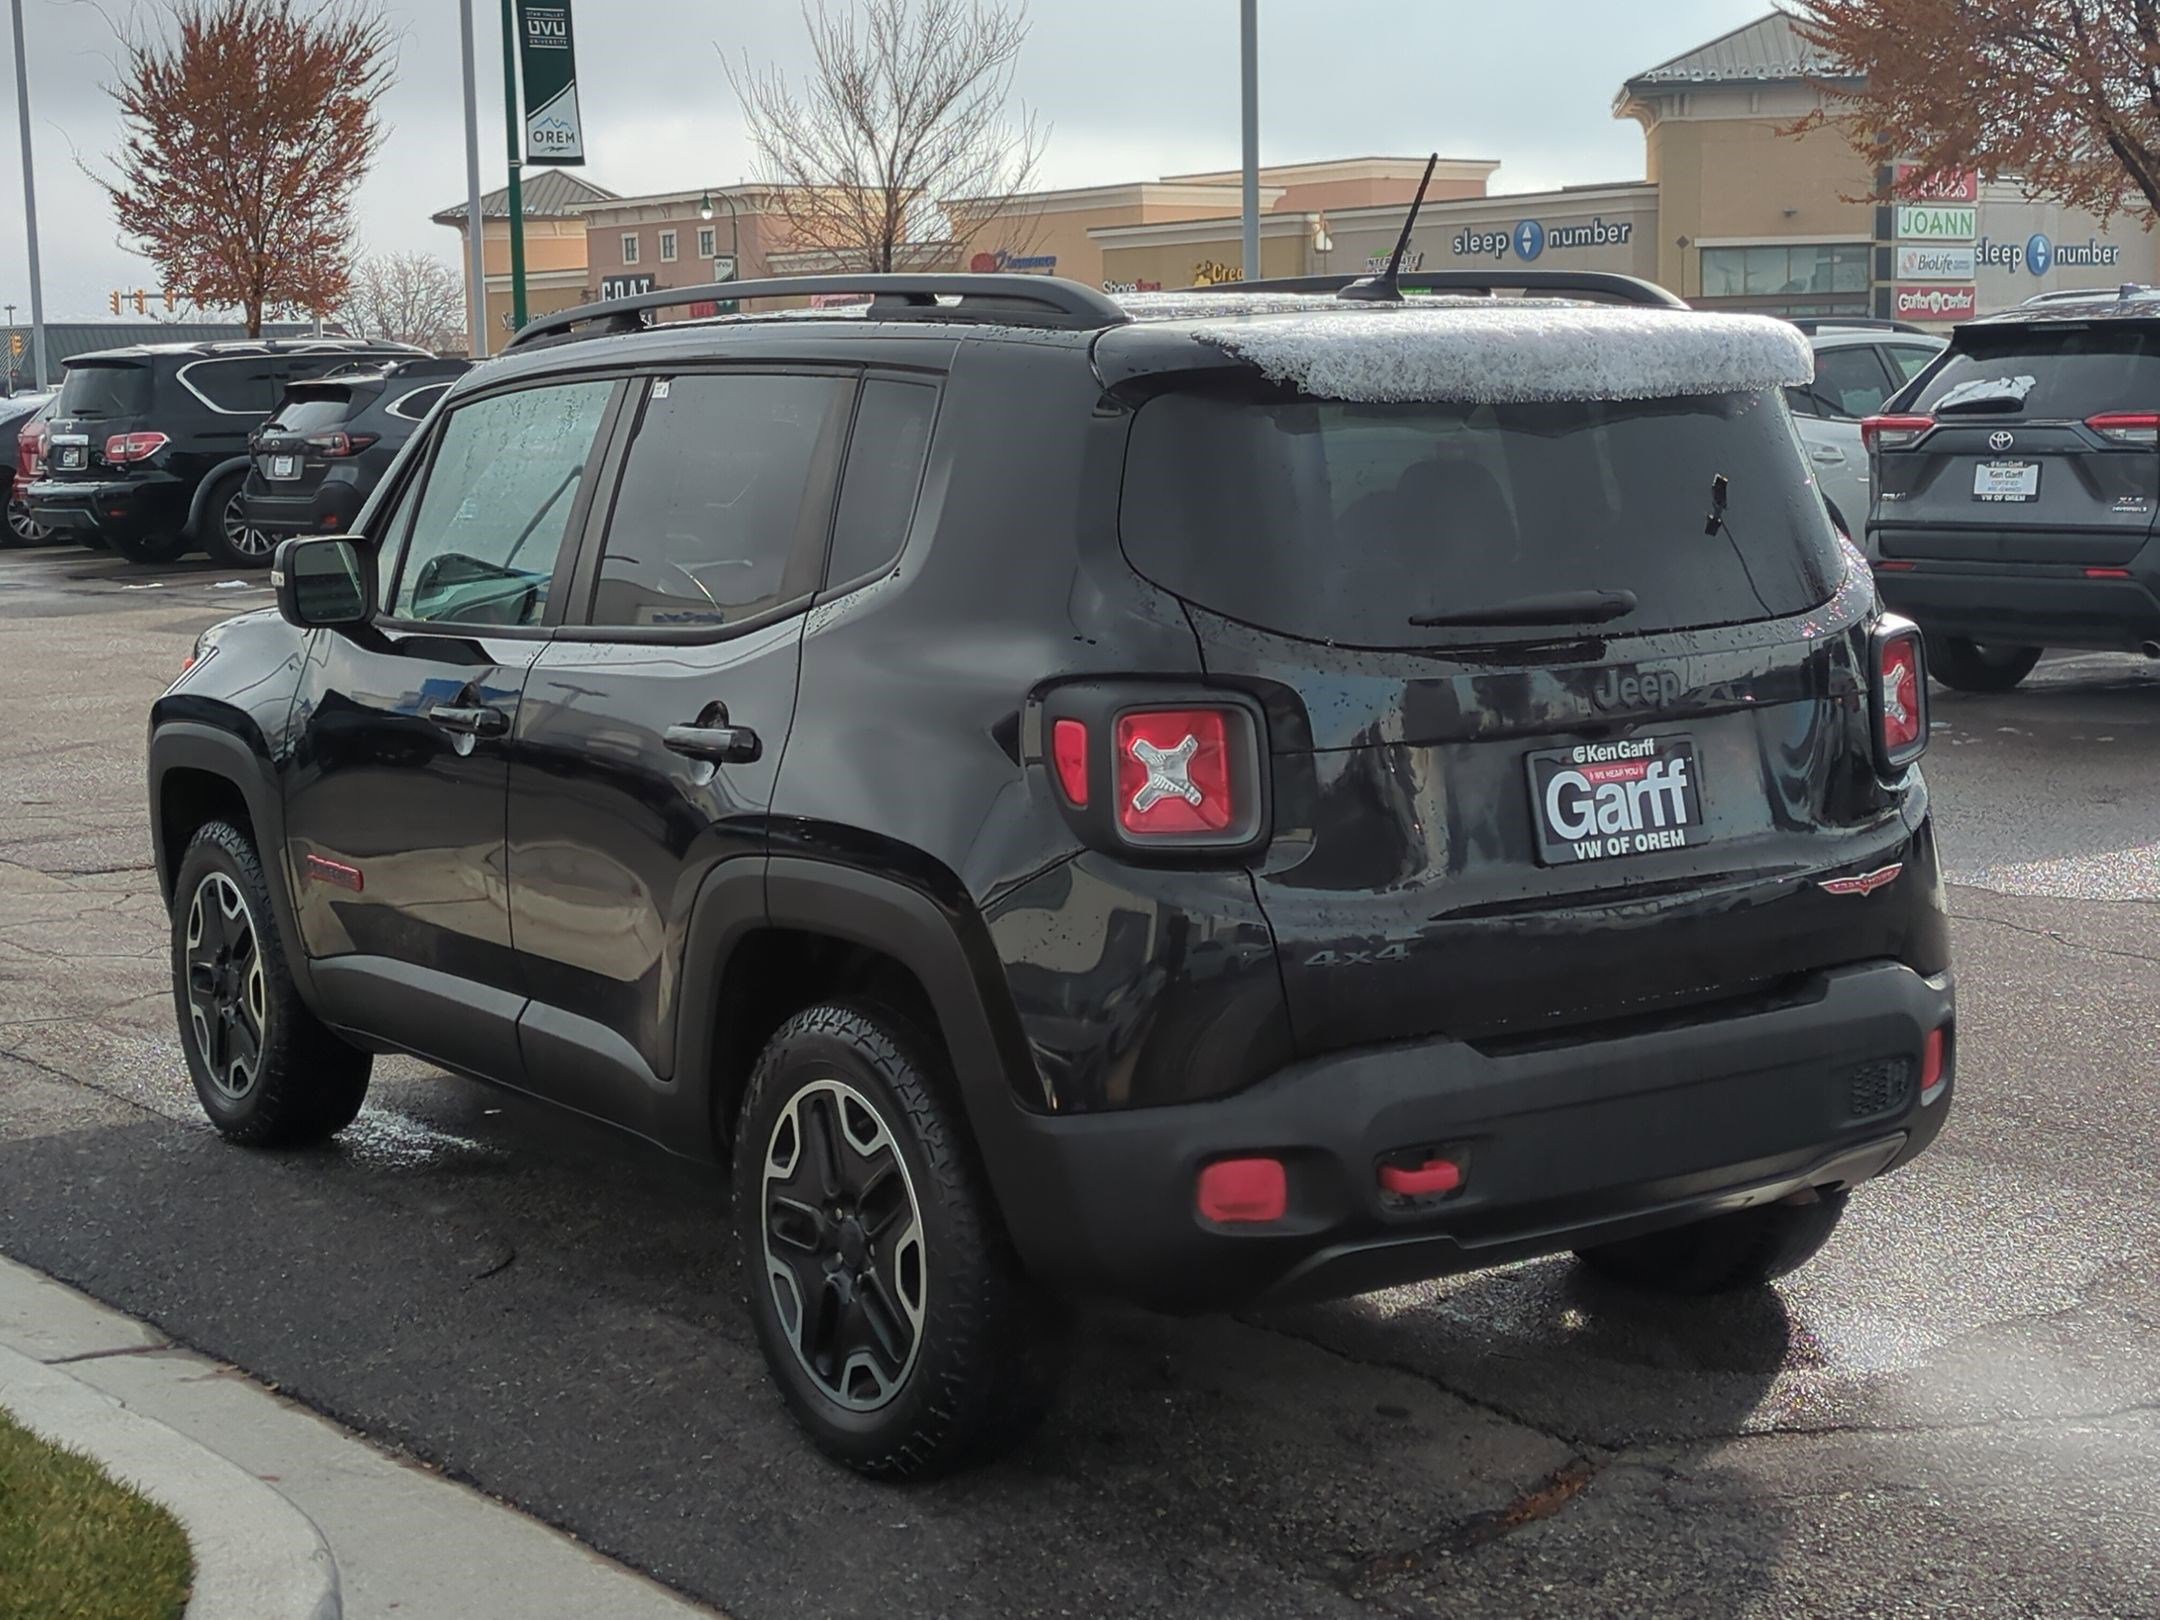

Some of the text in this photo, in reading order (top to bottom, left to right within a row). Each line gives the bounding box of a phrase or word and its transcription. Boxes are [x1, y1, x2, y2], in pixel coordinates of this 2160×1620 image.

[528, 20, 566, 36] UVU
[533, 131, 575, 143] OREM
[1903, 211, 1973, 235] JOANN
[1453, 218, 1631, 257] sleep number
[1918, 254, 1953, 275] BioLife
[1976, 238, 2119, 272] sleep number
[1899, 289, 1973, 311] Guitar Center
[1594, 668, 1680, 709] Jeep
[1624, 767, 1638, 776] YOU
[1546, 758, 1687, 840] Garff
[1573, 829, 1686, 860] VW OF OREM
